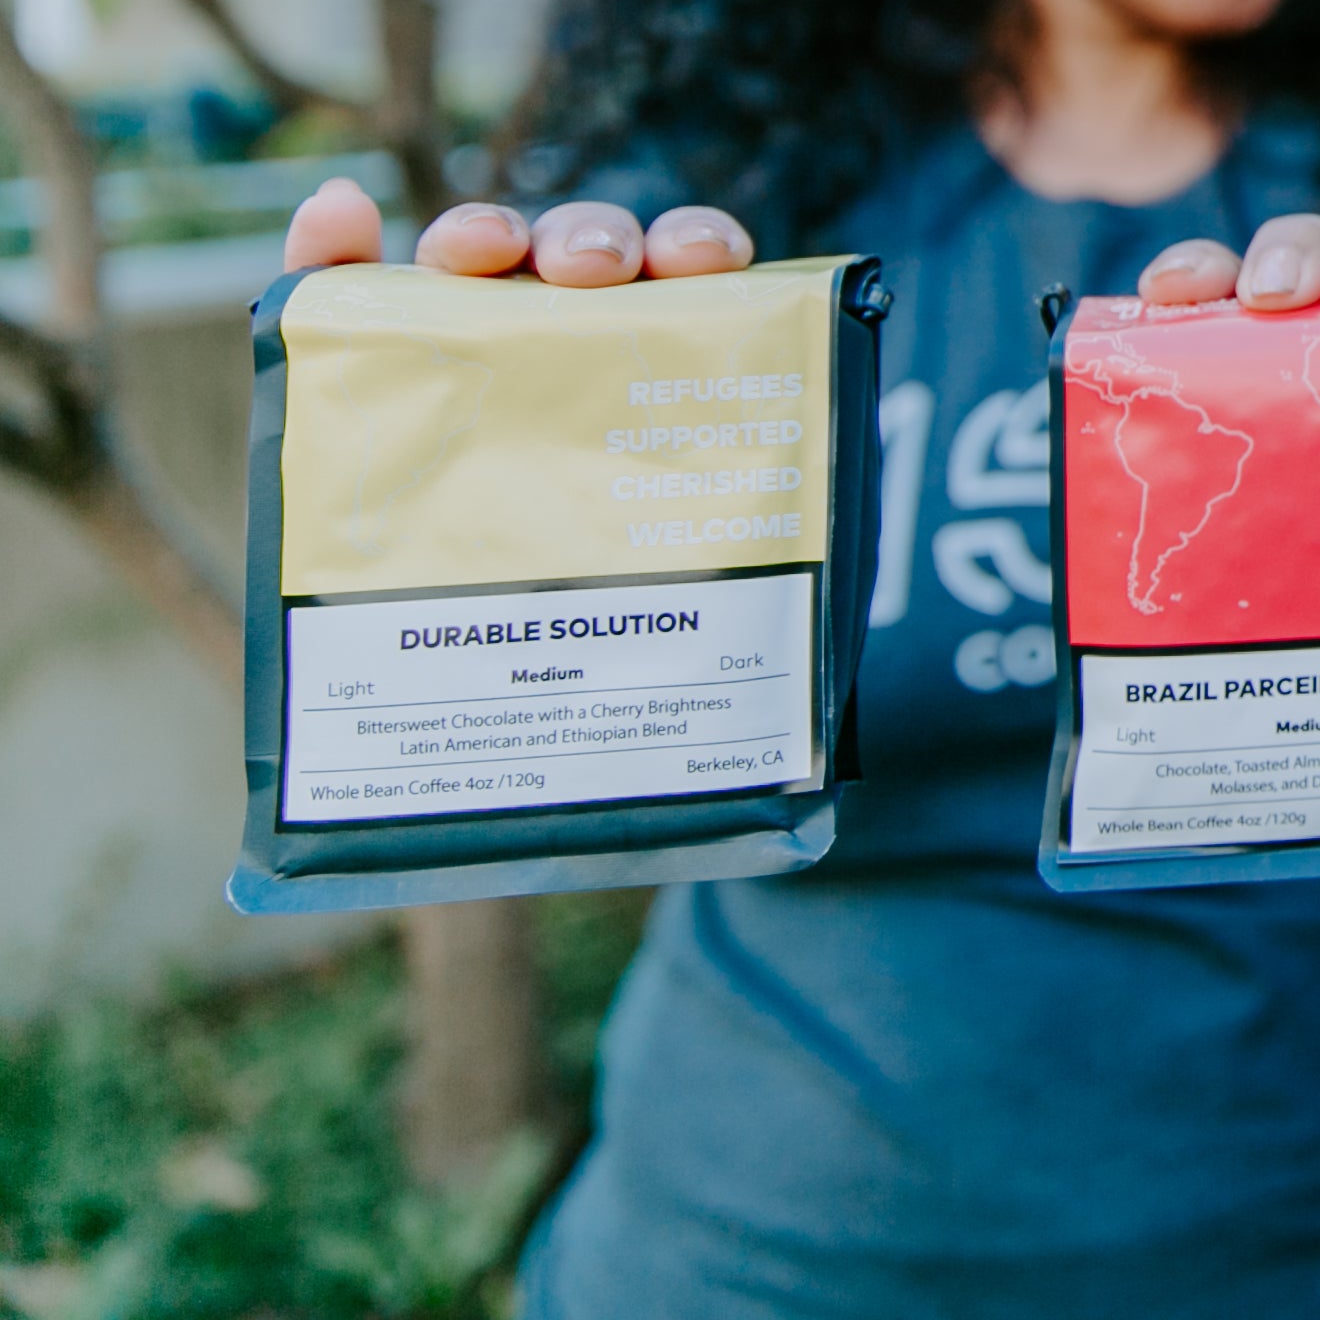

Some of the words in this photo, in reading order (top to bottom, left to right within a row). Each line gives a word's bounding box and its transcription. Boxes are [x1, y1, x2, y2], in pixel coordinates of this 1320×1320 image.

[628, 374, 803, 407] REFUGEES
[605, 419, 803, 454] SUPPORTED
[611, 466, 802, 501] CHERISHED
[627, 513, 801, 548] WELCOME
[400, 620, 542, 650] DURABLE
[549, 610, 699, 640] SOLUTION
[328, 680, 375, 699] Light
[511, 666, 583, 684] Medium
[720, 653, 764, 671] Dark
[1126, 682, 1218, 703] BRAZIL
[357, 717, 447, 735] Bittersweet
[451, 710, 533, 729] Chocolate
[538, 705, 574, 723] with
[578, 708, 587, 720] a
[591, 701, 644, 720] Cherry
[648, 697, 732, 717] Brightness
[400, 739, 439, 755] Latin
[444, 733, 522, 752] American
[526, 729, 557, 747] and
[562, 726, 638, 744] Ethiopian
[643, 721, 688, 737] Blend
[1116, 727, 1156, 745] Light
[687, 755, 758, 774] Berkeley,
[762, 750, 784, 766] CA
[1156, 762, 1231, 778] Chocolate,
[1235, 757, 1289, 774] Toasted
[311, 785, 359, 801] Whole
[363, 781, 404, 798] Bean
[408, 777, 461, 795] Coffee
[465, 776, 494, 791] 4oz
[497, 772, 545, 790] /120g
[1210, 781, 1278, 795] Molasses,
[1281, 776, 1308, 790] and
[1098, 819, 1144, 834] Whole
[1147, 817, 1183, 832] Bean
[1187, 814, 1233, 829] Coffee
[1236, 814, 1262, 827] 4oz
[1264, 811, 1307, 827] /120g
